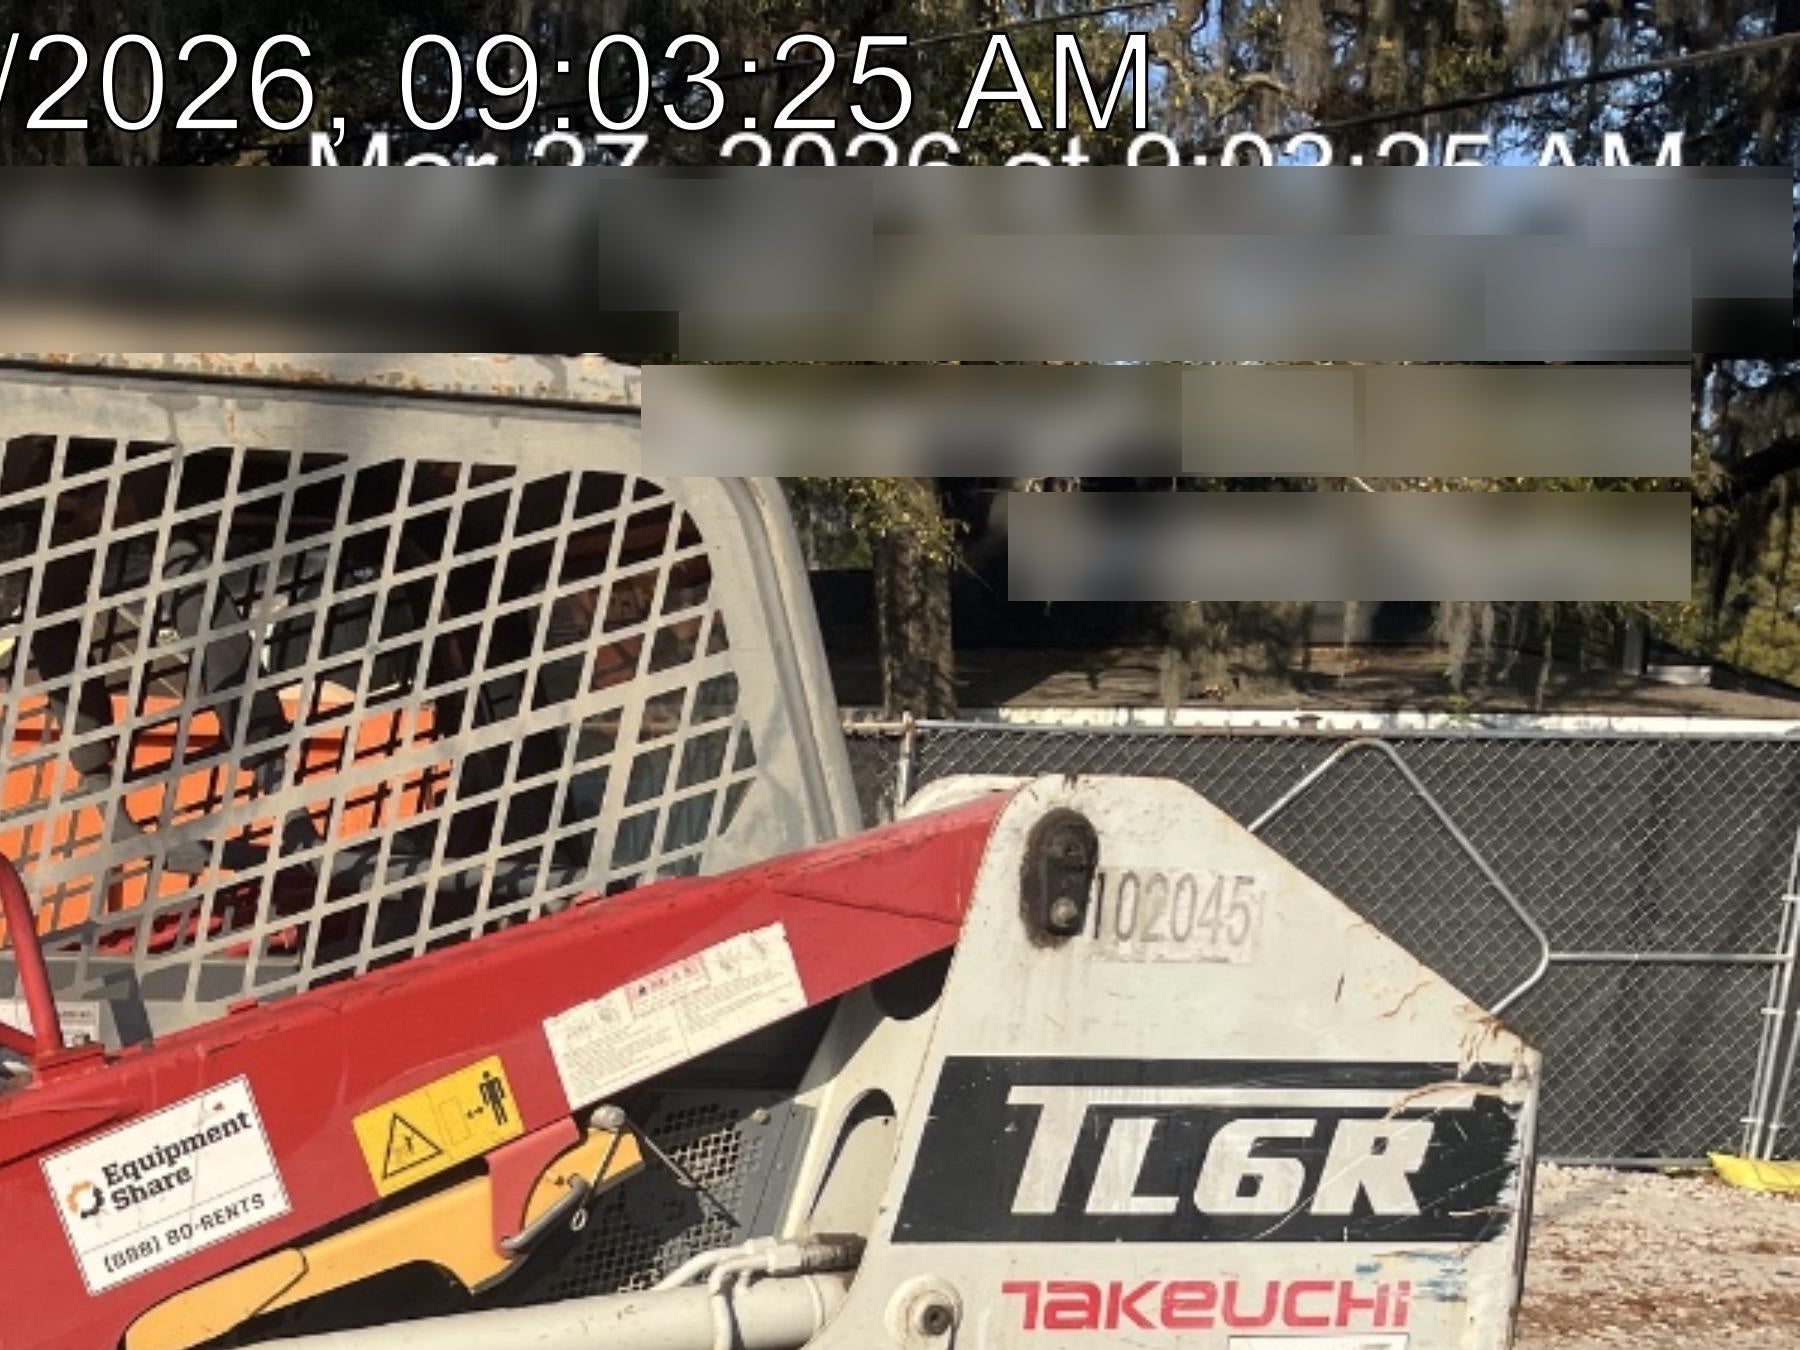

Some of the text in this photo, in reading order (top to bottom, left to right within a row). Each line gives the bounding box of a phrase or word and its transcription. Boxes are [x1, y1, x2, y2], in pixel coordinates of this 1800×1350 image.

[102, 1111, 251, 1187] Equipment
[1006, 1085, 1478, 1215] TL6R
[110, 1165, 193, 1211] Share
